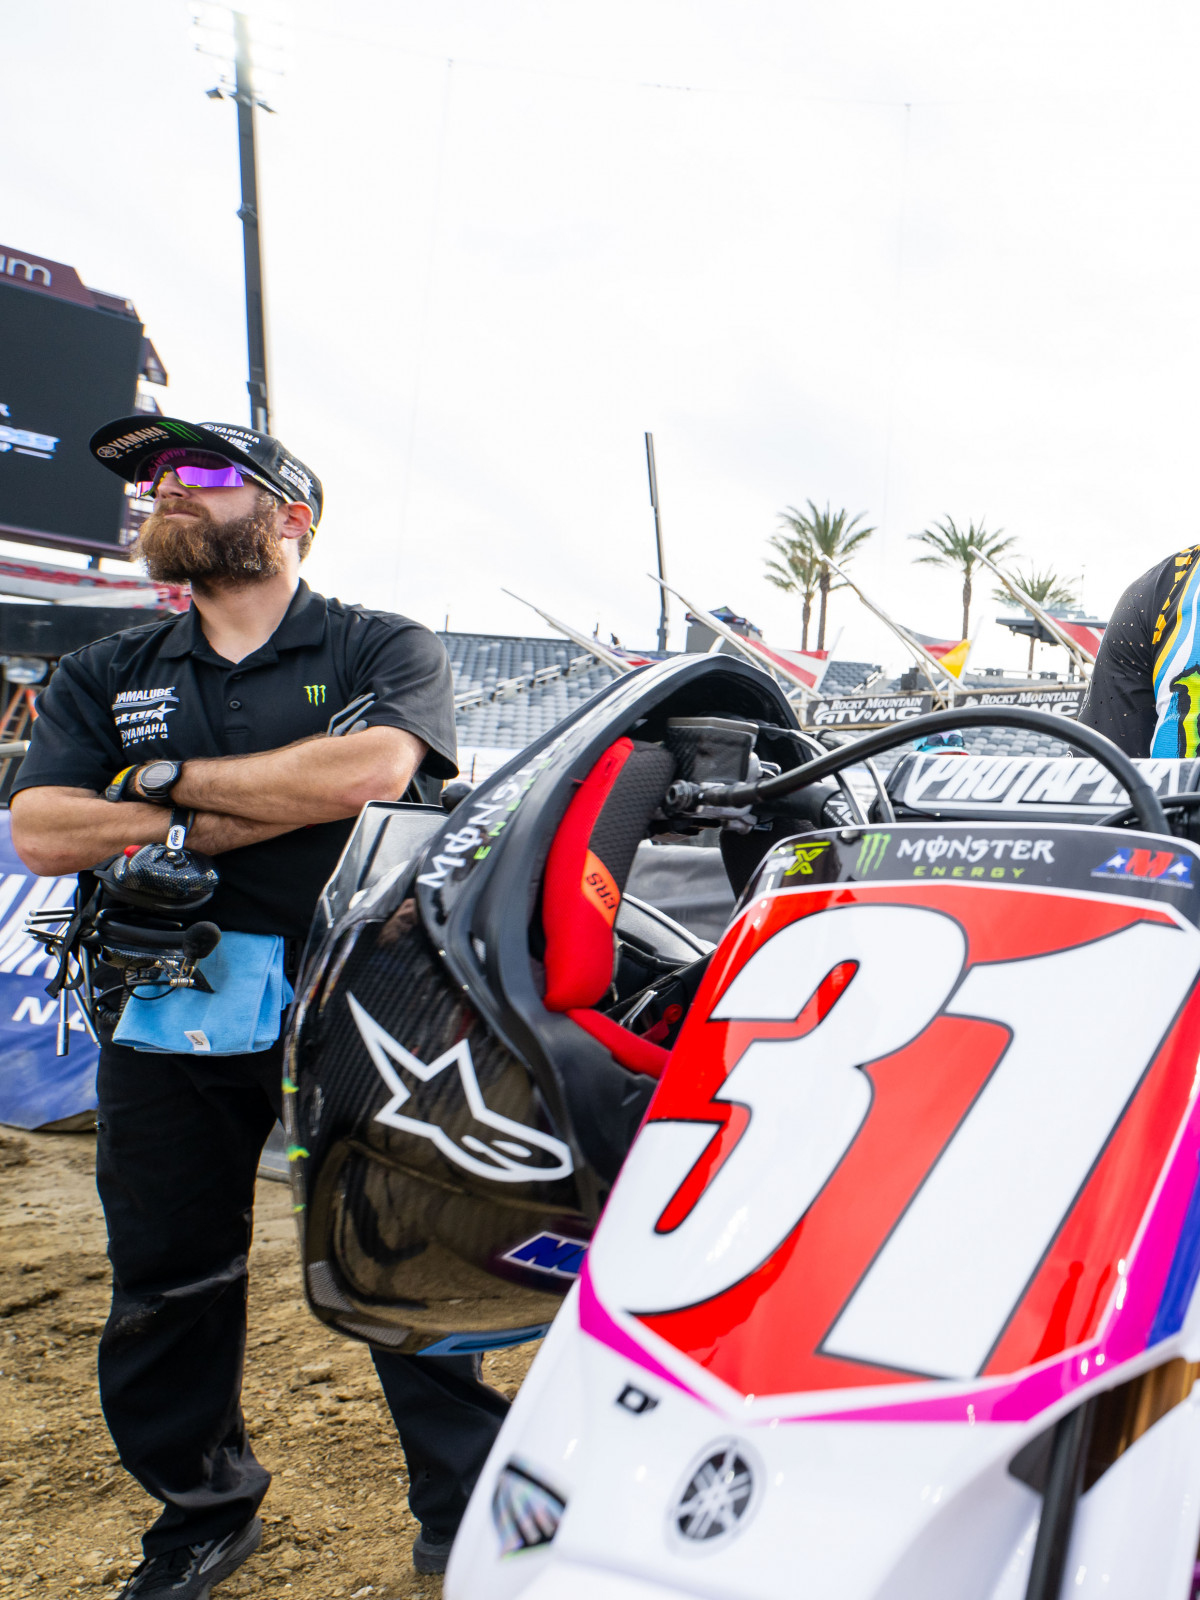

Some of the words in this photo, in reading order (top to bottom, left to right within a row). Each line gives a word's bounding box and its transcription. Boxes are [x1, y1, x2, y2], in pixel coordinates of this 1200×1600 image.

[107, 426, 168, 450] YAMAHA
[213, 425, 260, 443] YAMAHA
[831, 700, 866, 710] ROCKY
[865, 697, 923, 708] MOUNTAIN
[980, 694, 1018, 705] ROCKY
[1017, 691, 1080, 703] MOUNTAIN
[126, 722, 168, 740] YAMAHA
[896, 835, 1055, 864] MONSTER
[913, 866, 1025, 879] ENERGY
[1091, 847, 1194, 884] AMA
[588, 902, 1190, 1381] 31
